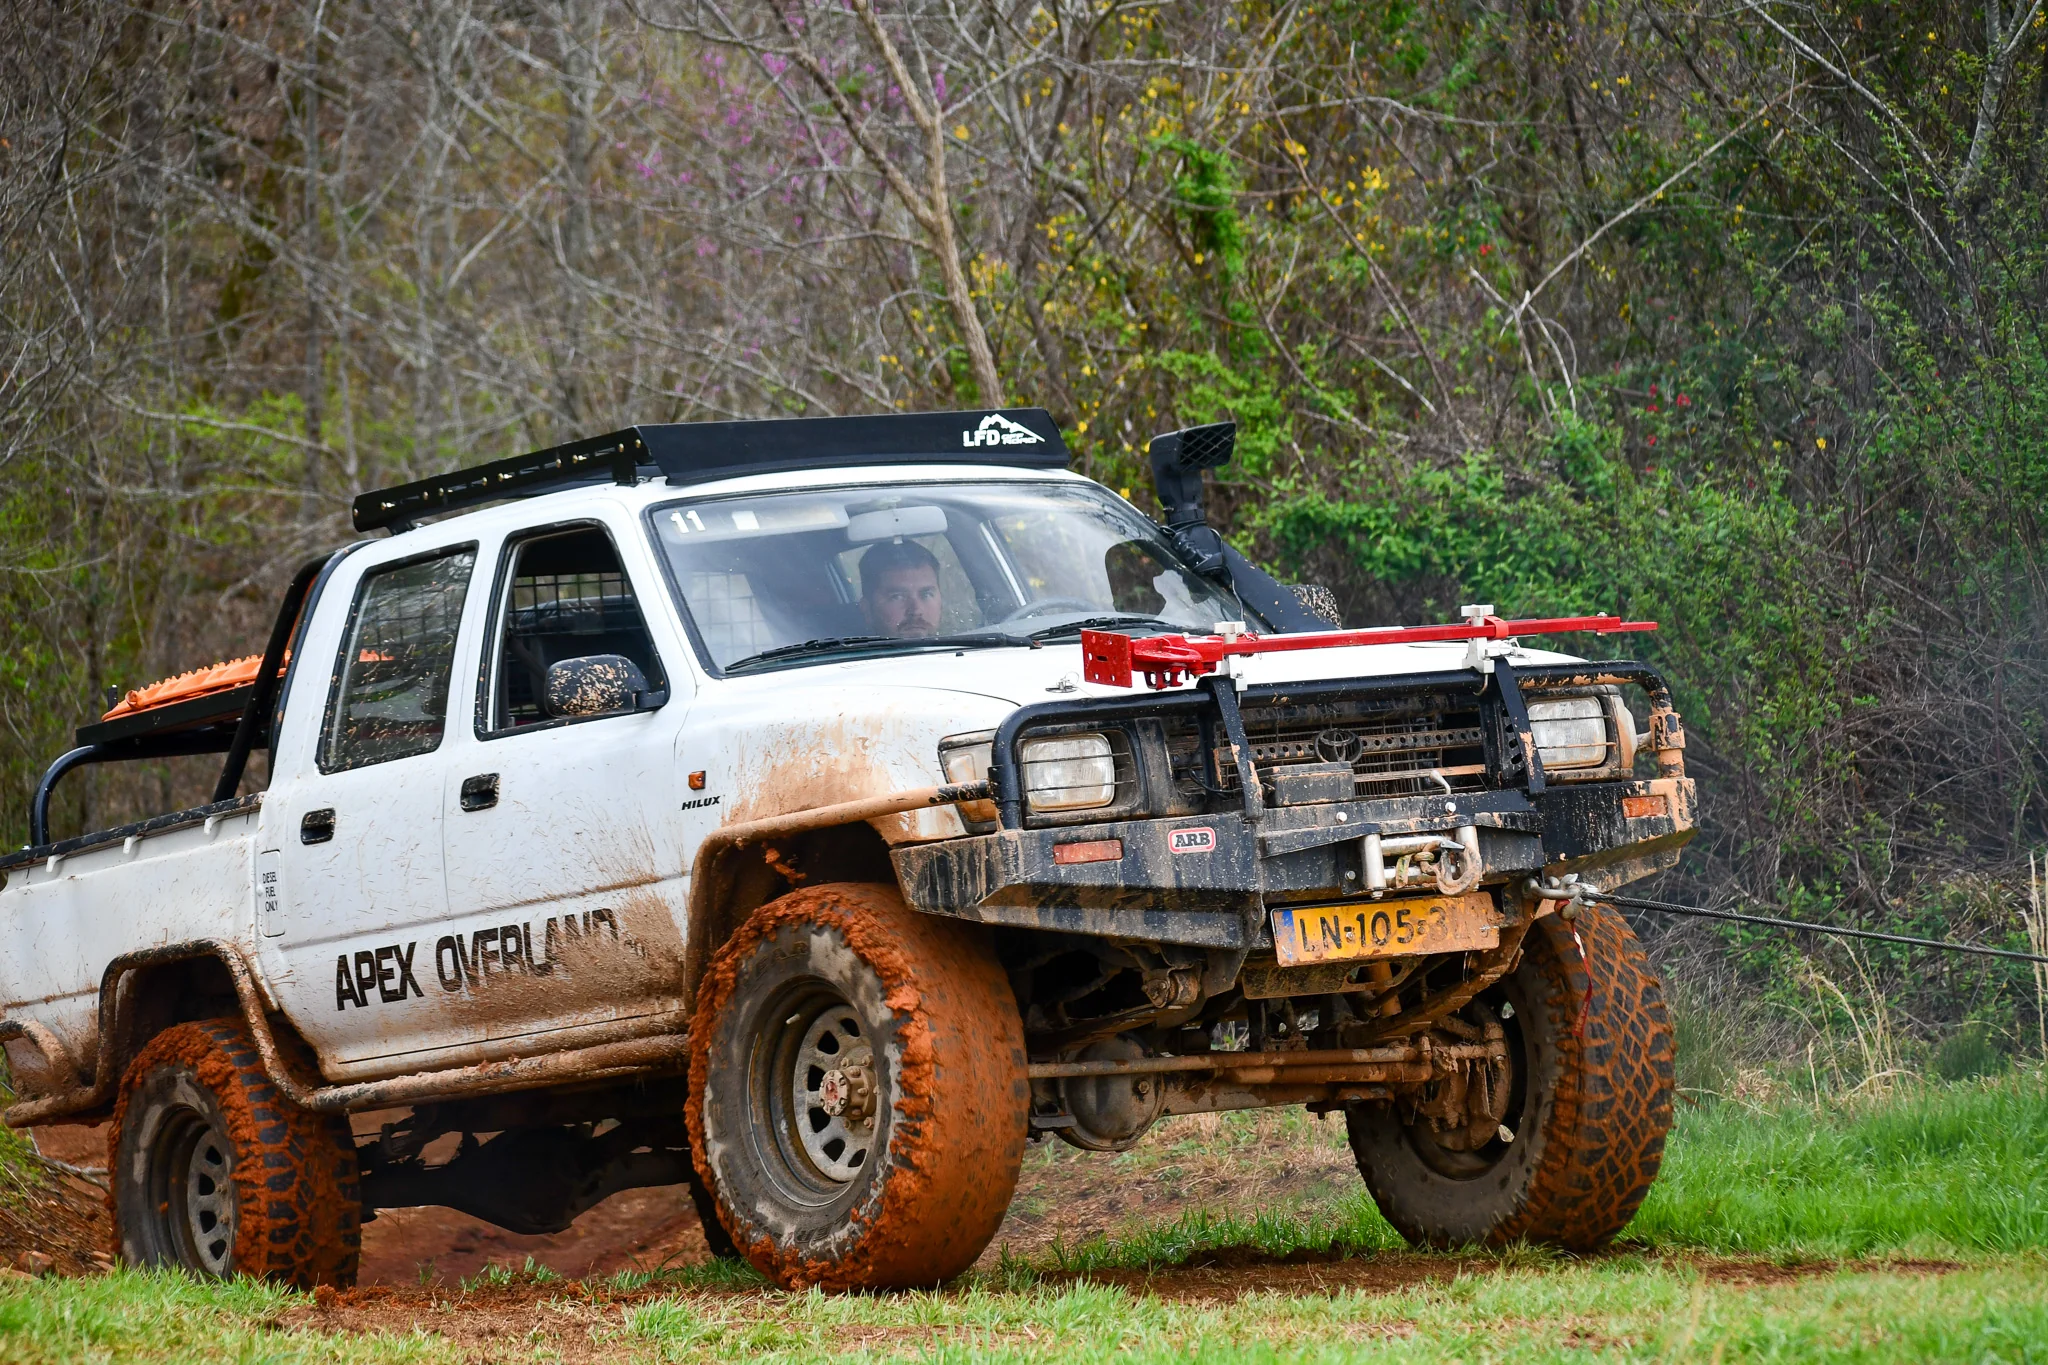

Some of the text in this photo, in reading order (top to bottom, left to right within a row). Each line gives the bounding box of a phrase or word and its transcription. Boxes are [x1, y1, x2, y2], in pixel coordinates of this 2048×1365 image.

[962, 429, 1000, 447] LFD
[670, 510, 706, 533] 11
[681, 795, 721, 810] HILUX
[1174, 832, 1211, 848] ARB
[262, 871, 278, 884] DIESEL
[265, 886, 277, 898] FUEL
[265, 900, 279, 912] ONLY
[336, 941, 425, 1011] APEX
